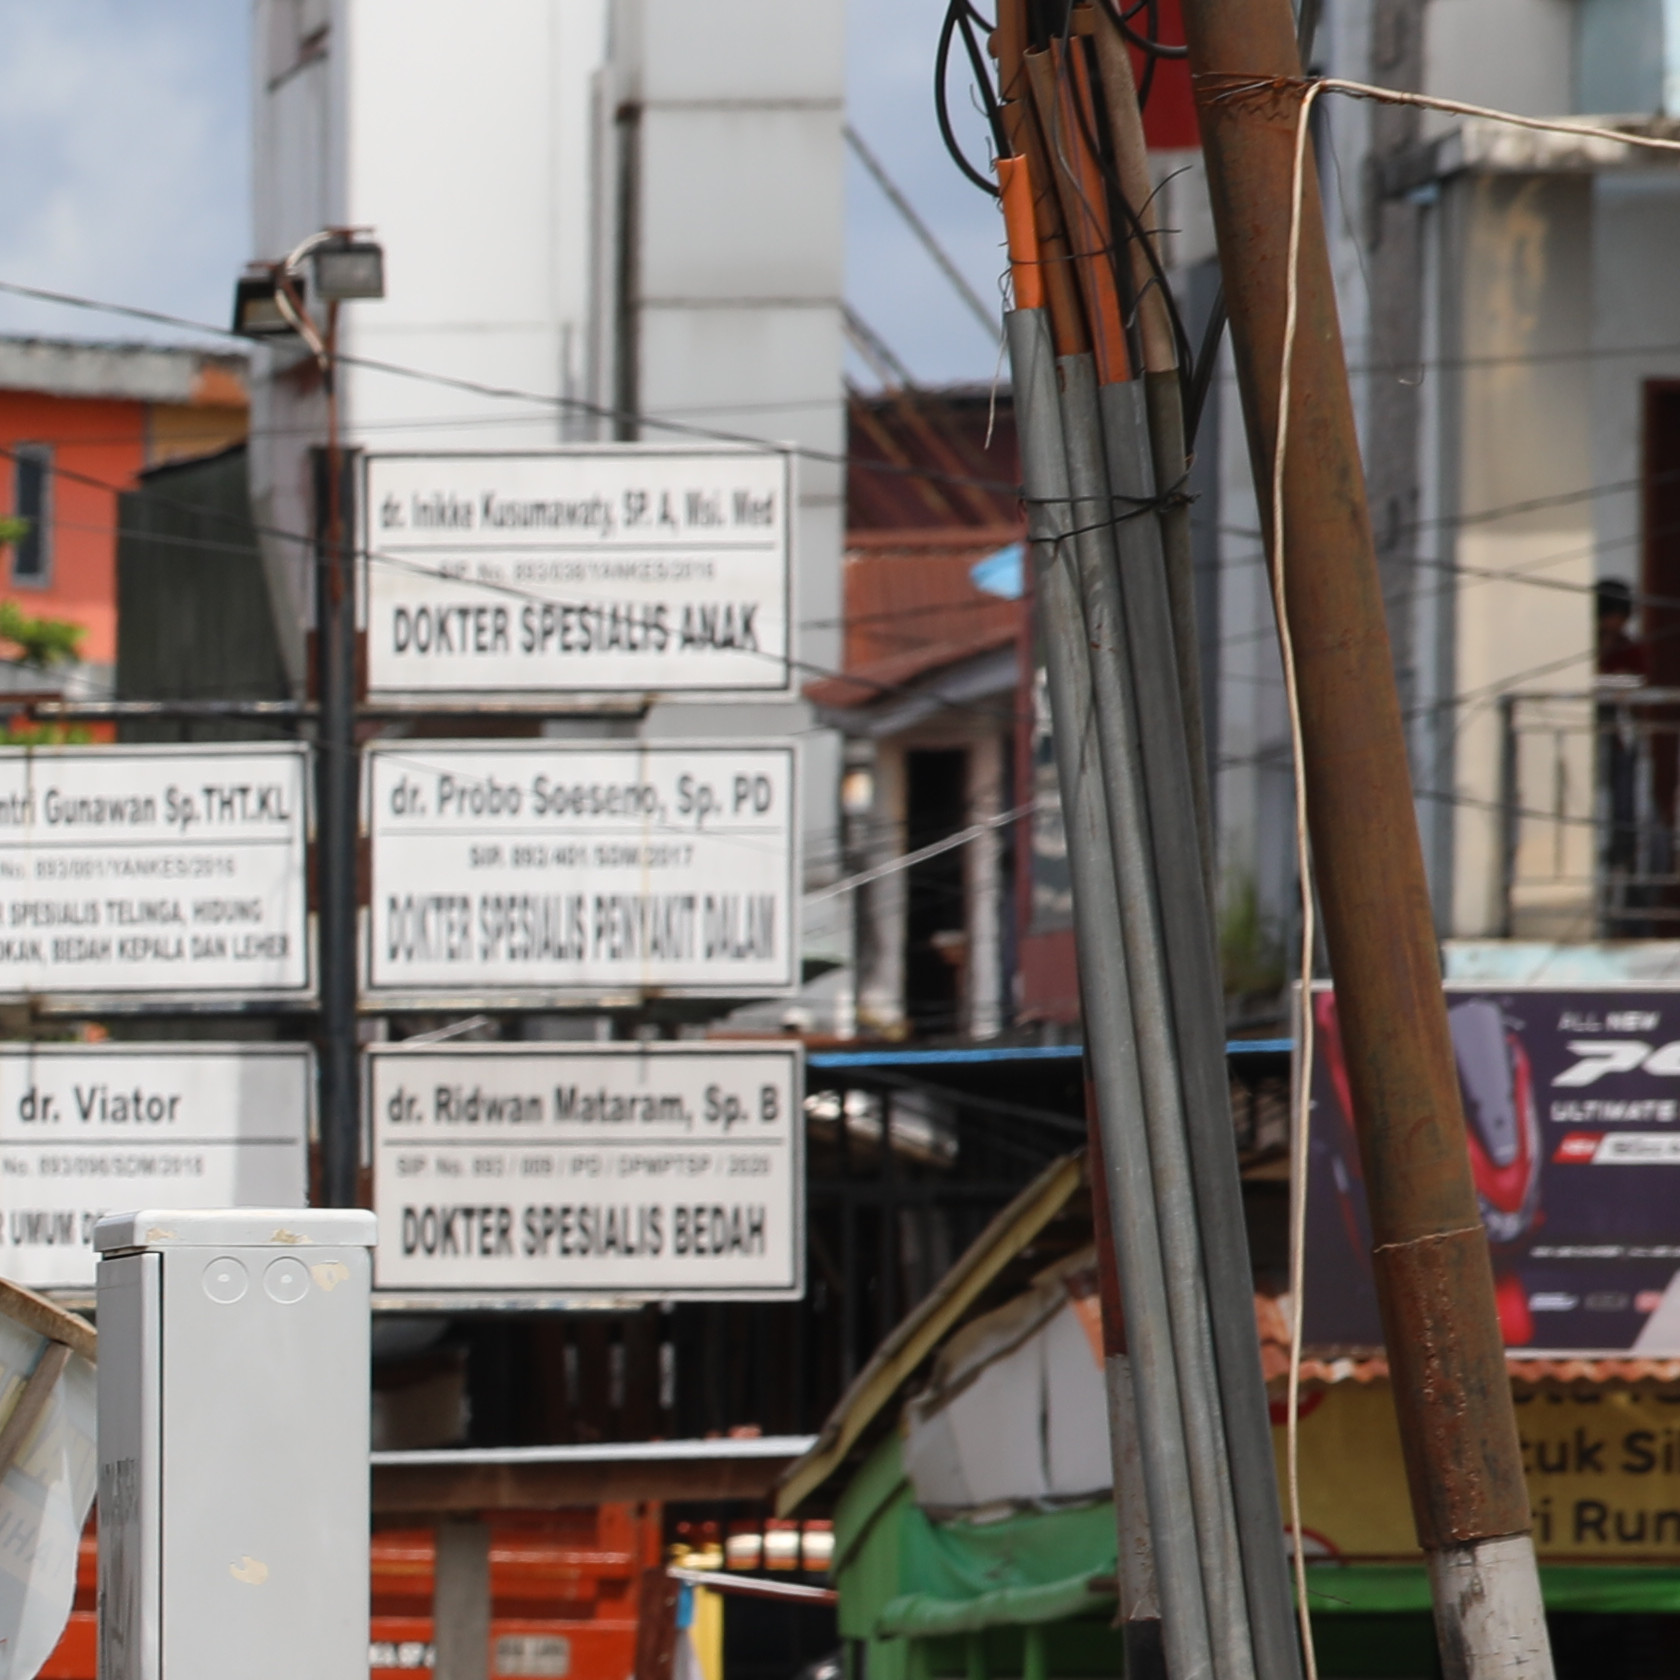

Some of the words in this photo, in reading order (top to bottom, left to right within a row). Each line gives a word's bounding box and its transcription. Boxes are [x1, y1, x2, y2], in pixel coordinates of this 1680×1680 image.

[393, 607, 509, 655] DOKTER
[521, 605, 668, 654] SPESIALIS
[681, 605, 761, 652] ANAK
[45, 788, 156, 827] Gunawan
[391, 776, 426, 817] dr.
[437, 775, 521, 816] Probo
[677, 776, 722, 829] Sp.
[734, 776, 773, 815] PD
[389, 896, 471, 960] DOKTER
[481, 895, 584, 959] SPESIALIS
[20, 1086, 60, 1125] dr.
[74, 1086, 182, 1125] Viator
[389, 1088, 424, 1123] dr.
[435, 1086, 543, 1123] Ridwan
[555, 1086, 692, 1130] Mataram,
[703, 1085, 749, 1131] Sp.
[761, 1085, 779, 1122] B
[10, 1211, 76, 1245] UMUM
[402, 1207, 513, 1257] DOKTER
[523, 1206, 662, 1257] SPESIALIS
[675, 1206, 765, 1256] BEDAH
